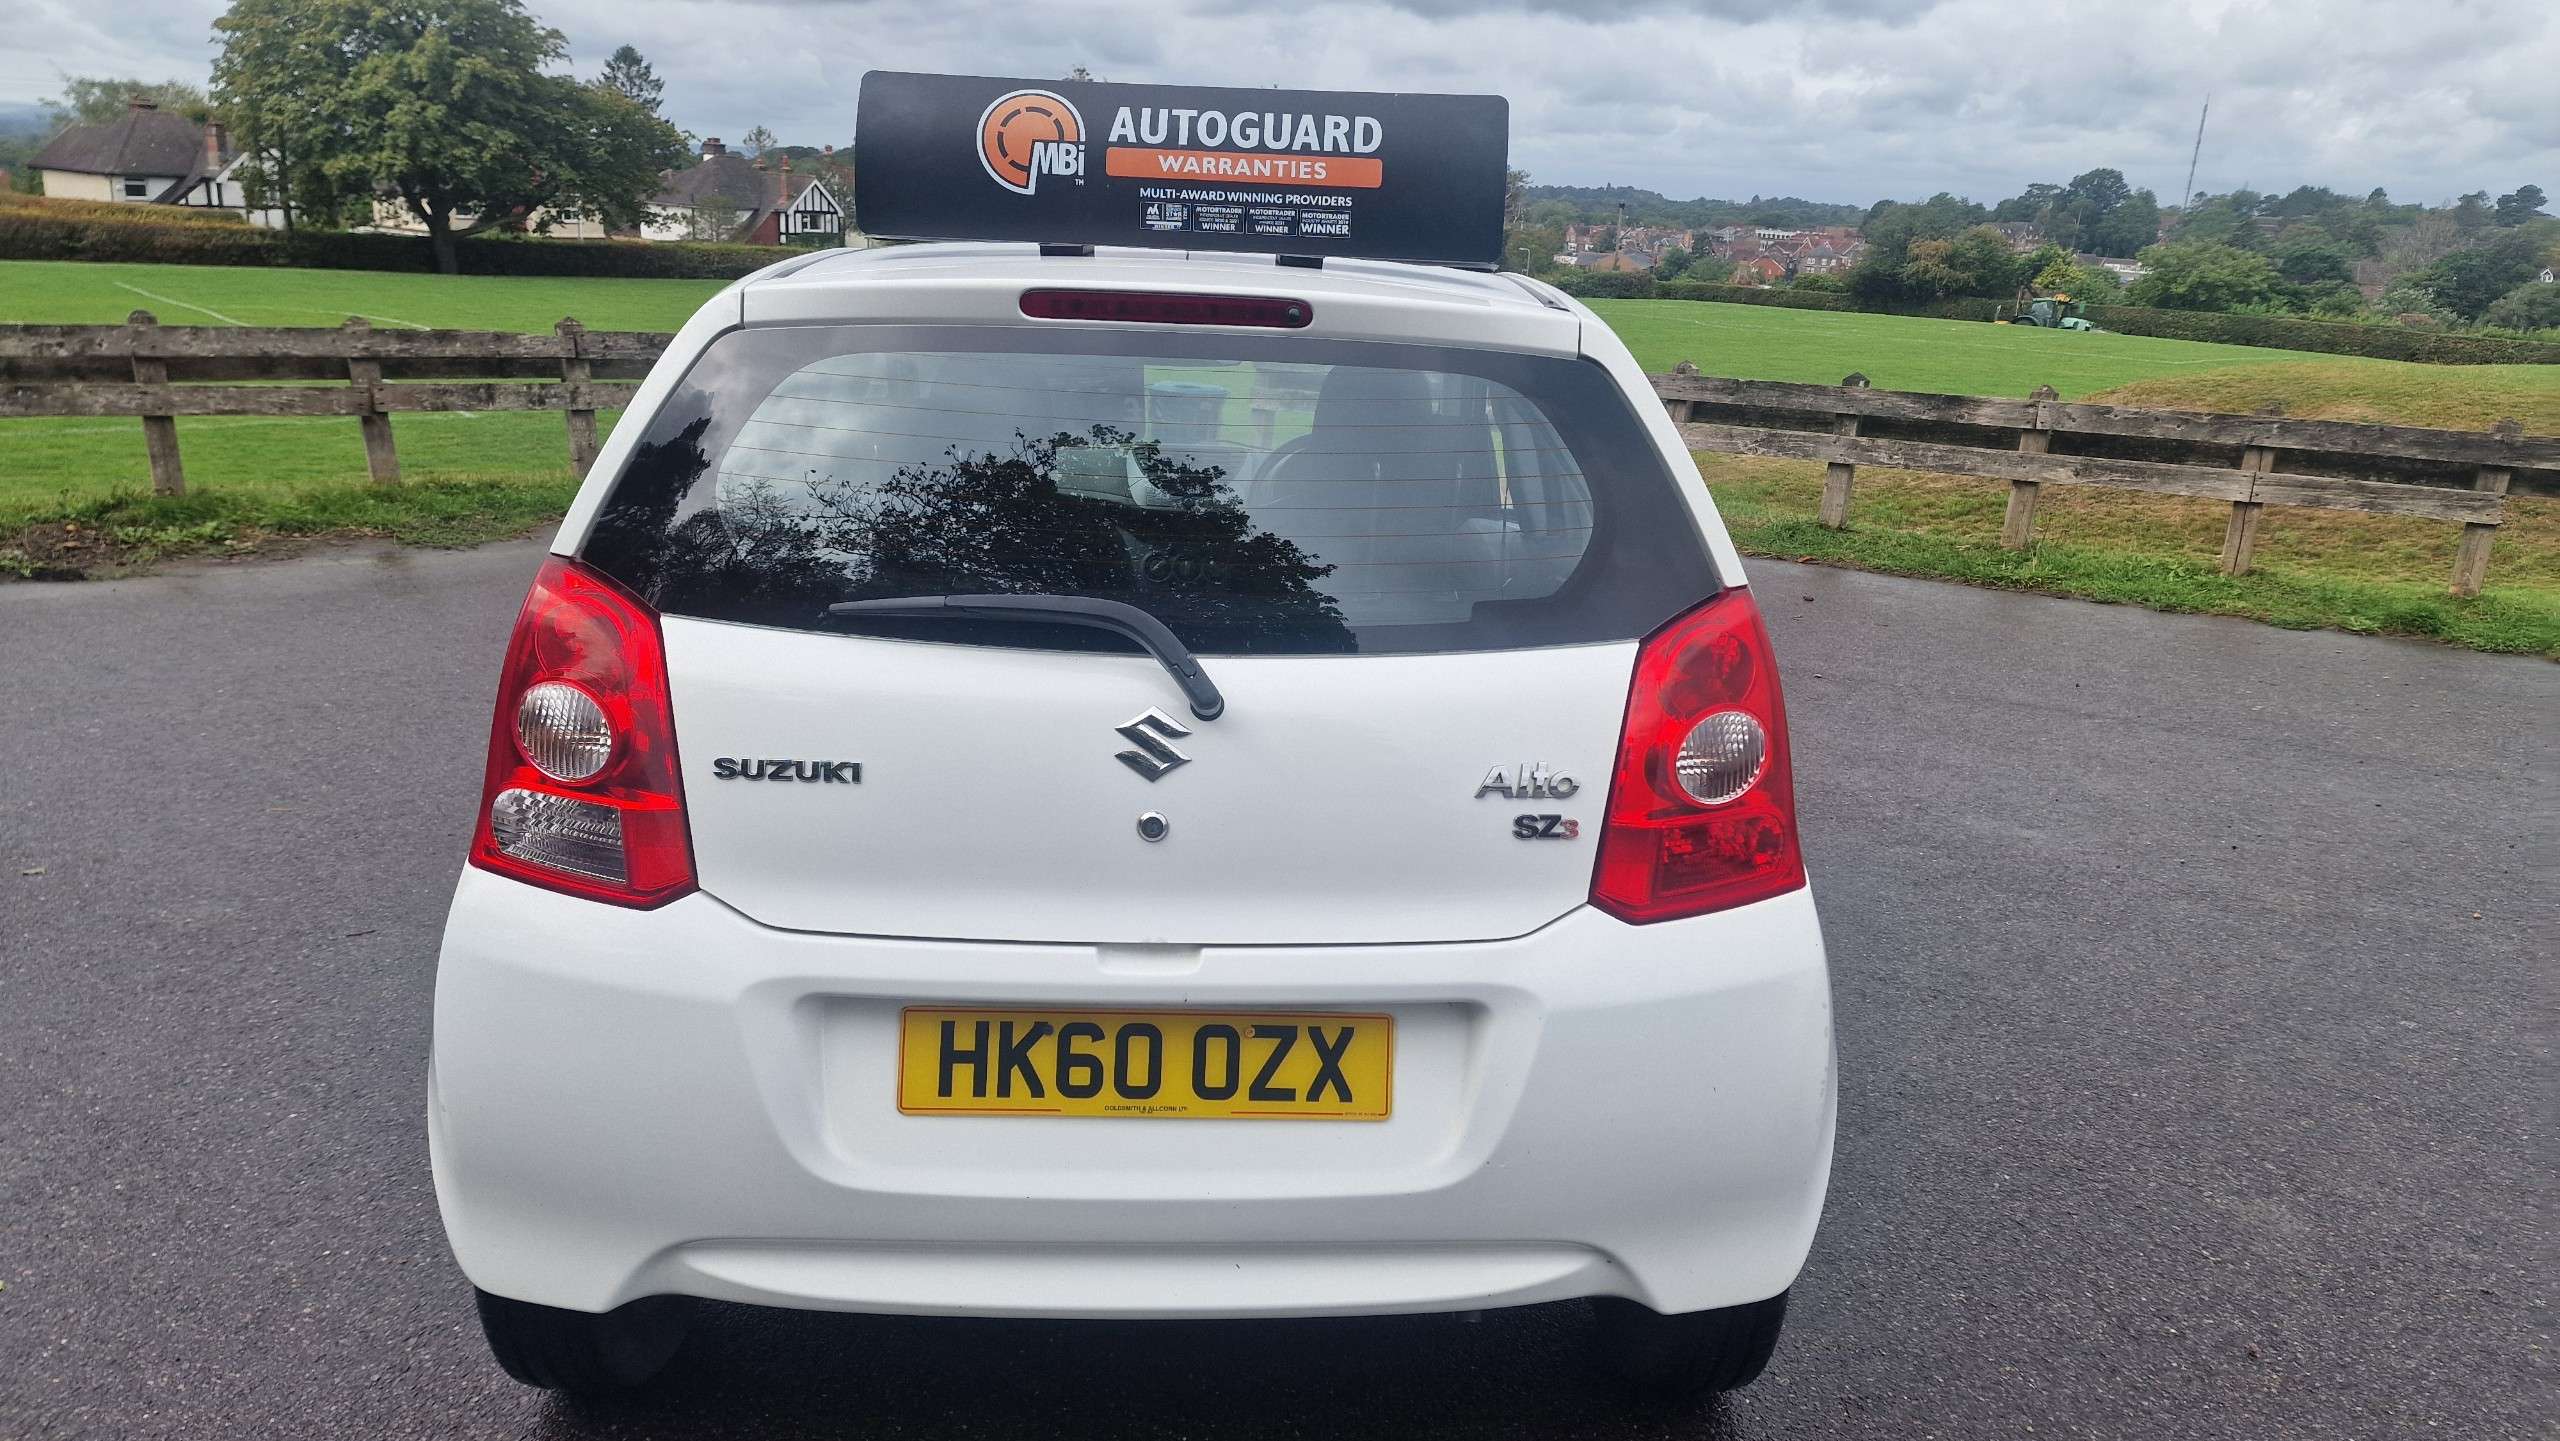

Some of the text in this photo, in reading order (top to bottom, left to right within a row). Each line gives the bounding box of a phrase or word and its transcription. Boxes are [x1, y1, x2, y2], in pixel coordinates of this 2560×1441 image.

[1108, 105, 1383, 153] AUTOGUARD
[1031, 141, 1086, 176] MBi
[1158, 154, 1328, 180] WARRANTIES
[1139, 187, 1353, 207] MULTI-AWARD WINNING PROVIDERS
[1201, 222, 1236, 231] WINNER
[1255, 224, 1289, 234] WINNER
[1301, 223, 1349, 235] WINNER
[713, 757, 863, 784] SUZUKI
[1474, 760, 1580, 800] Alto
[1512, 814, 1579, 839] SZ3
[937, 1020, 1356, 1103] HK60 OZX
